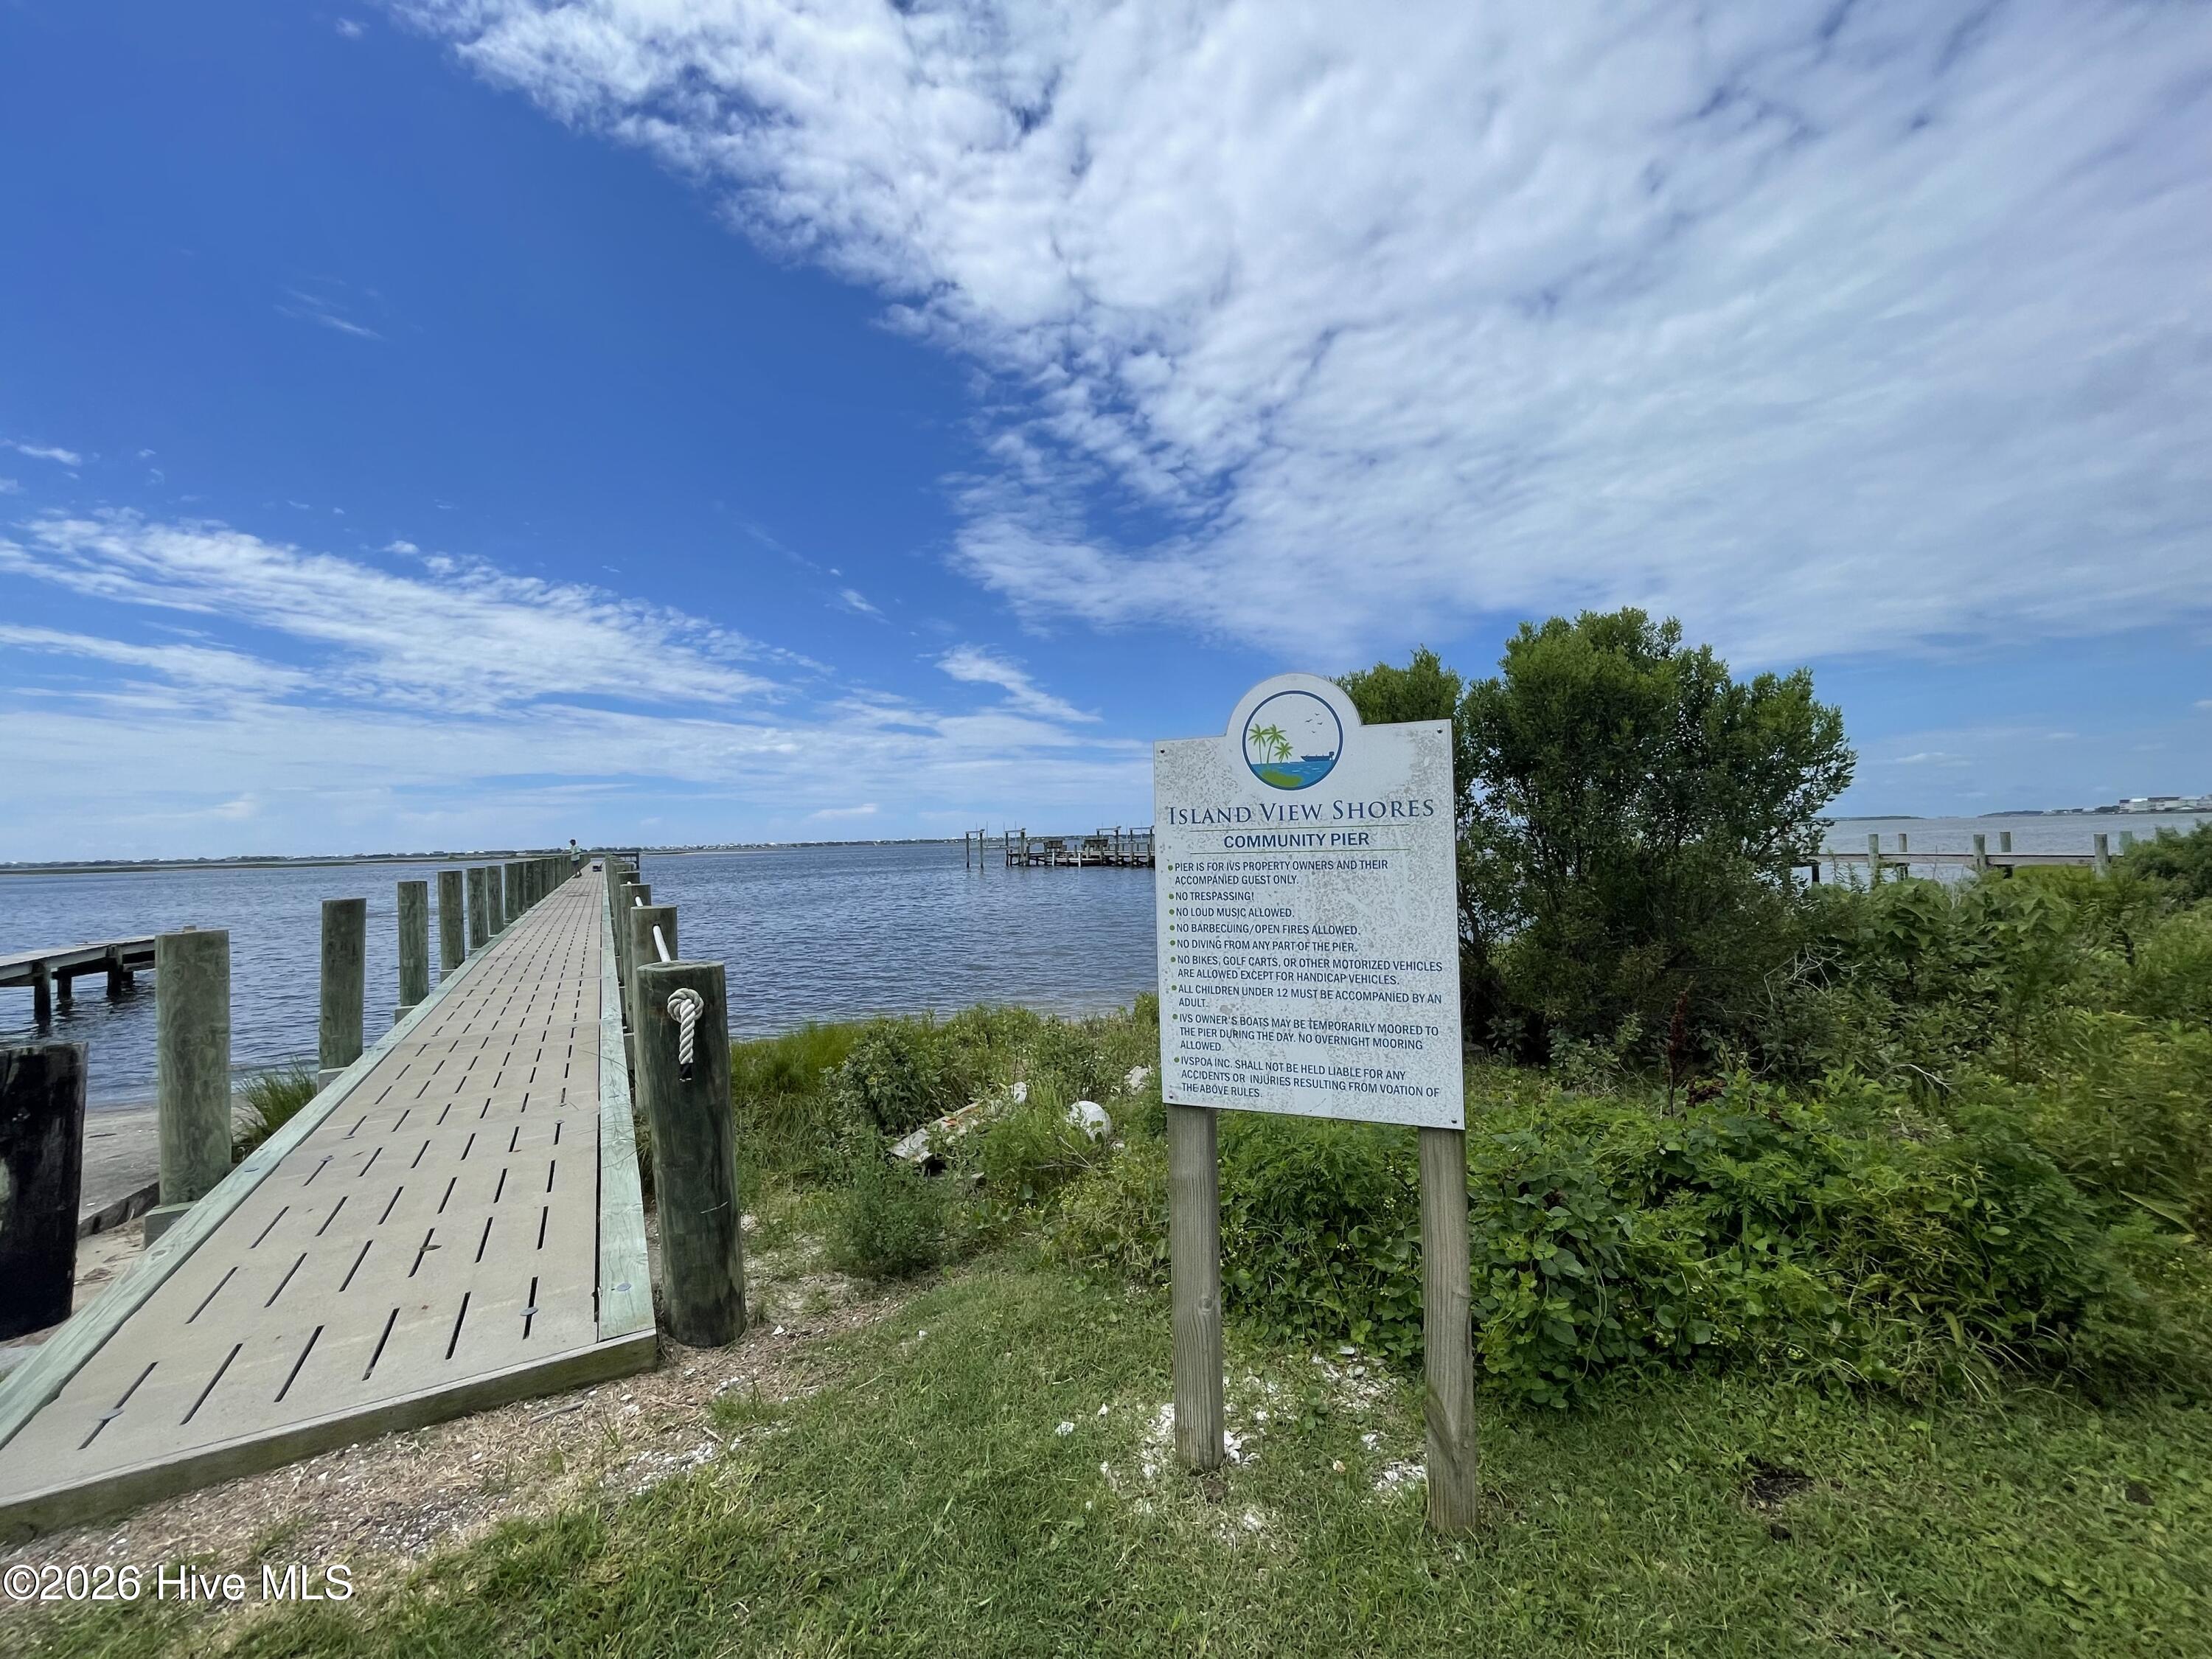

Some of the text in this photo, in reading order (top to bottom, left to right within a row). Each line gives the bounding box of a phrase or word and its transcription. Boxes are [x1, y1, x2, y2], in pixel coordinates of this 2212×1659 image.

[1224, 832, 1369, 849] COMMUNITY PIER
[1175, 860, 1388, 872] PIER IS FOR IVS PROPERTY OWNERS AND THEIR
[1175, 875, 1298, 885] ACCOMPANIED GUEST ONLY.
[1176, 892, 1254, 900] NO TRESPASSING!
[1176, 908, 1295, 917] NO LOUD MUSIC ALLOWED.
[1177, 924, 1189, 932] NO
[1283, 925, 1309, 934] FIRES
[1312, 925, 1360, 935] ALLOWED.
[1177, 940, 1357, 952] NO DIVING FROM ANY PART OF THE PIER.
[1178, 956, 1442, 971] NO BIKES, GOLF CARTS, OR OTHER MOTORIZED VEHICLES
[1178, 969, 1399, 985] ARE ALLOWED EXCEPT FOR HANDICAP VEHICLES.
[1178, 985, 1441, 1004] ALL CHILDREN UNDER 12 MUST BE ACCOMPANIED BY AN
[1180, 1014, 1193, 1023] IVS
[1196, 1015, 1238, 1025] OWNER'S
[1240, 1017, 1269, 1027] BOATS
[1271, 1018, 1291, 1028] MAY
[1294, 1020, 1305, 1029] BE
[1378, 1024, 1423, 1035] MOORED
[1425, 1026, 1439, 1036] TO
[1180, 1027, 1423, 1049] THE PIER DURING THE DAY. NO OVERNIGHT MOORING
[1180, 1040, 1223, 1051] ALLOWED.
[1181, 1057, 1406, 1080] IVSPOA INC. SHALL NOT BE HELD LIABLE FOR ANY
[1181, 1070, 1439, 1097] ACCIDENTS OR INJURIES RESULTING FROM VOATION OF
[1182, 1082, 1262, 1098] THE ABOVE RULES.
